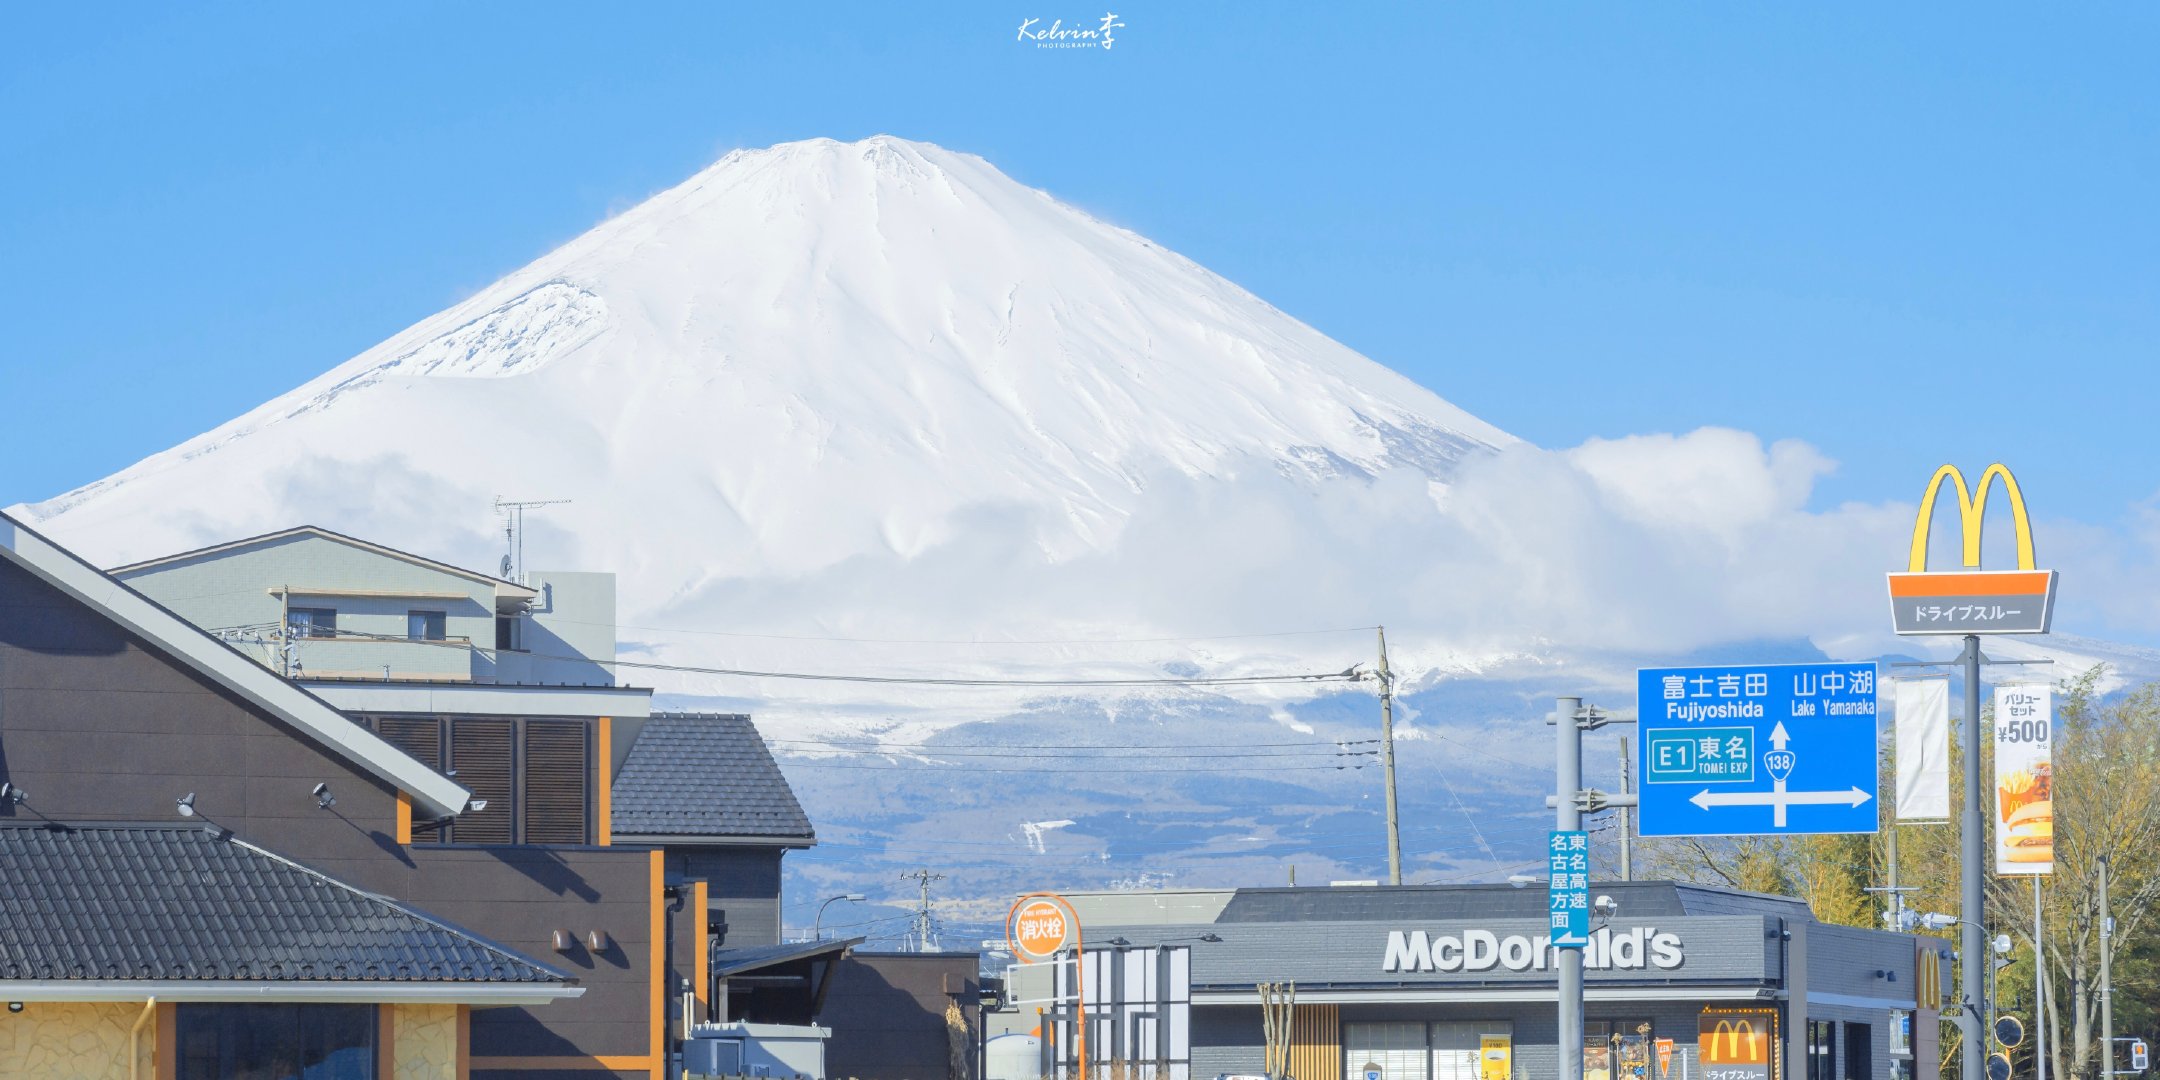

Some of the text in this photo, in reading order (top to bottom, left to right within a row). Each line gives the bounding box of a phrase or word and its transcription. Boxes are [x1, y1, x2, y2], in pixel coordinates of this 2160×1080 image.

[1915, 604, 2021, 622] ドライブスルー
[1662, 670, 1873, 700] 富士吉田 山中湖
[1791, 698, 1875, 717] Lake Yamanaka
[2005, 694, 2041, 705] バリュー
[1666, 701, 1764, 722] Fujiyoshida
[2009, 706, 2036, 716] セット
[1998, 720, 2048, 743] ¥500
[1698, 736, 1747, 760] 東名
[1698, 762, 1748, 774] TOMEI EXP
[1768, 755, 1791, 770] 138
[1551, 834, 1569, 929] 名古屋方面
[1568, 834, 1587, 909] 東名高速
[1021, 917, 1062, 941] 消火栓
